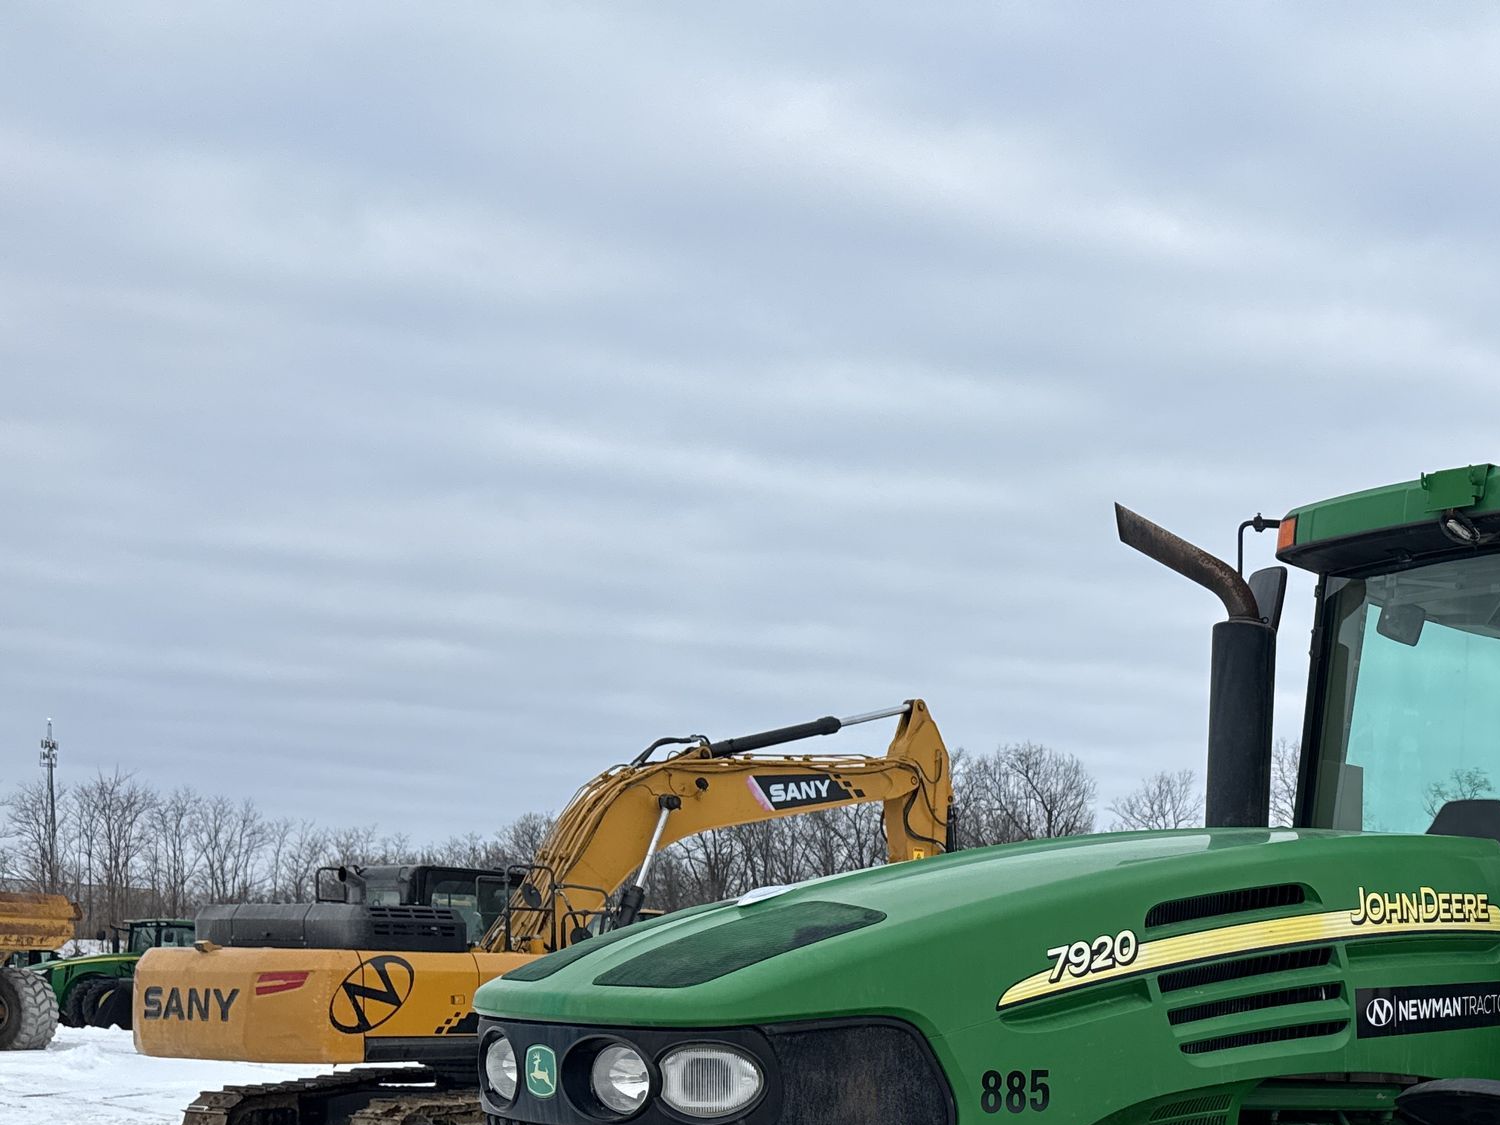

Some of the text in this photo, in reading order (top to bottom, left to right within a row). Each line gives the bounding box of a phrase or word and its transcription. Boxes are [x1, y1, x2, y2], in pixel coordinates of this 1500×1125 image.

[769, 780, 830, 802] SANY
[1350, 886, 1490, 925] JOHN DEERE
[1047, 930, 1138, 983] 7920
[144, 986, 240, 1022] SANY
[981, 1069, 1049, 1114] 885
